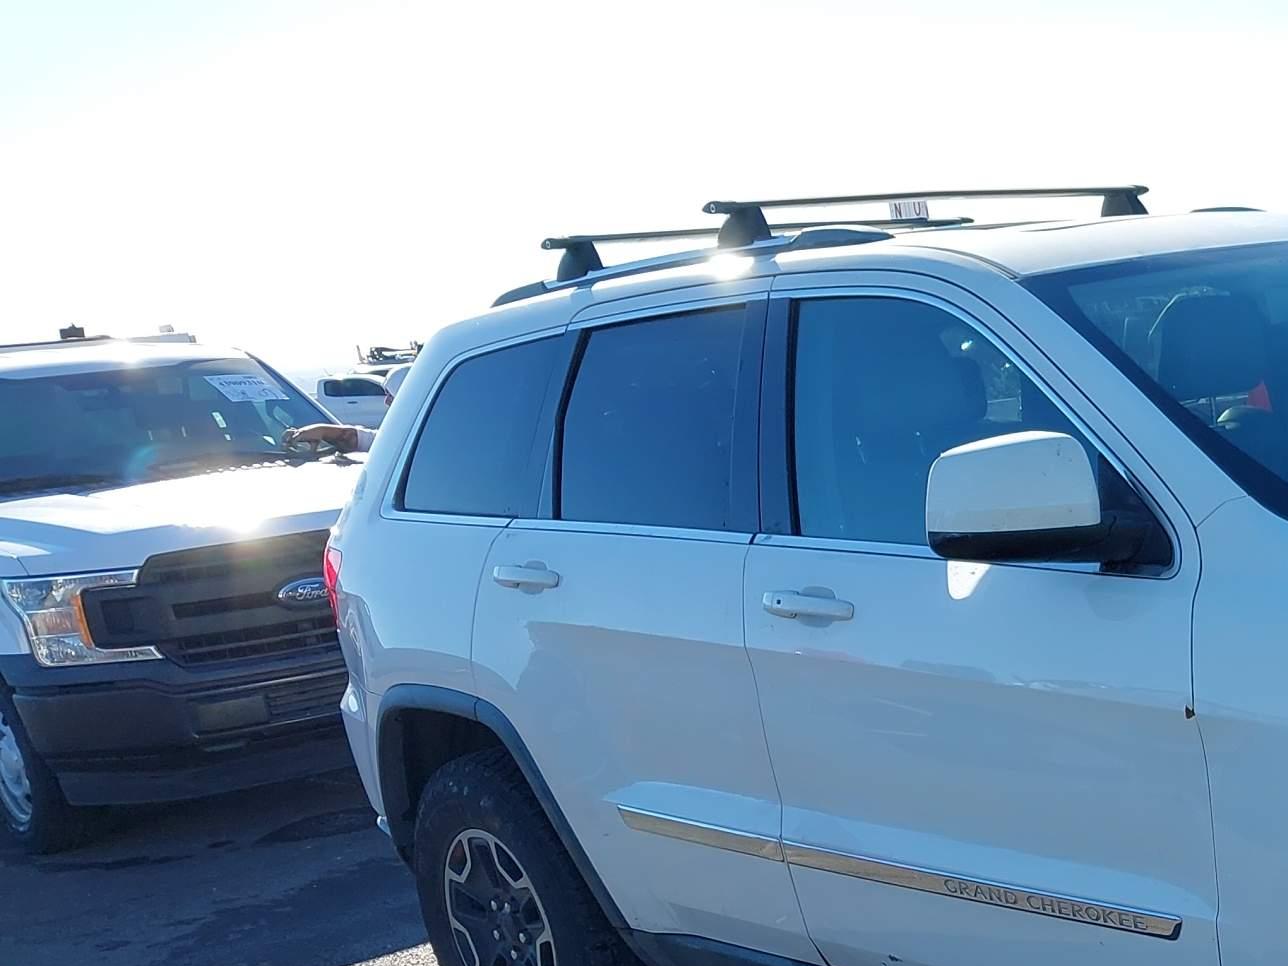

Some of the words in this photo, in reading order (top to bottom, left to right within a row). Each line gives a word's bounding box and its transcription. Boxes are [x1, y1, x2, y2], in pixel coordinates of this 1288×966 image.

[296, 583, 329, 600] Ford
[943, 879, 1018, 905] GRAND
[1026, 896, 1149, 931] CHEROKEE
